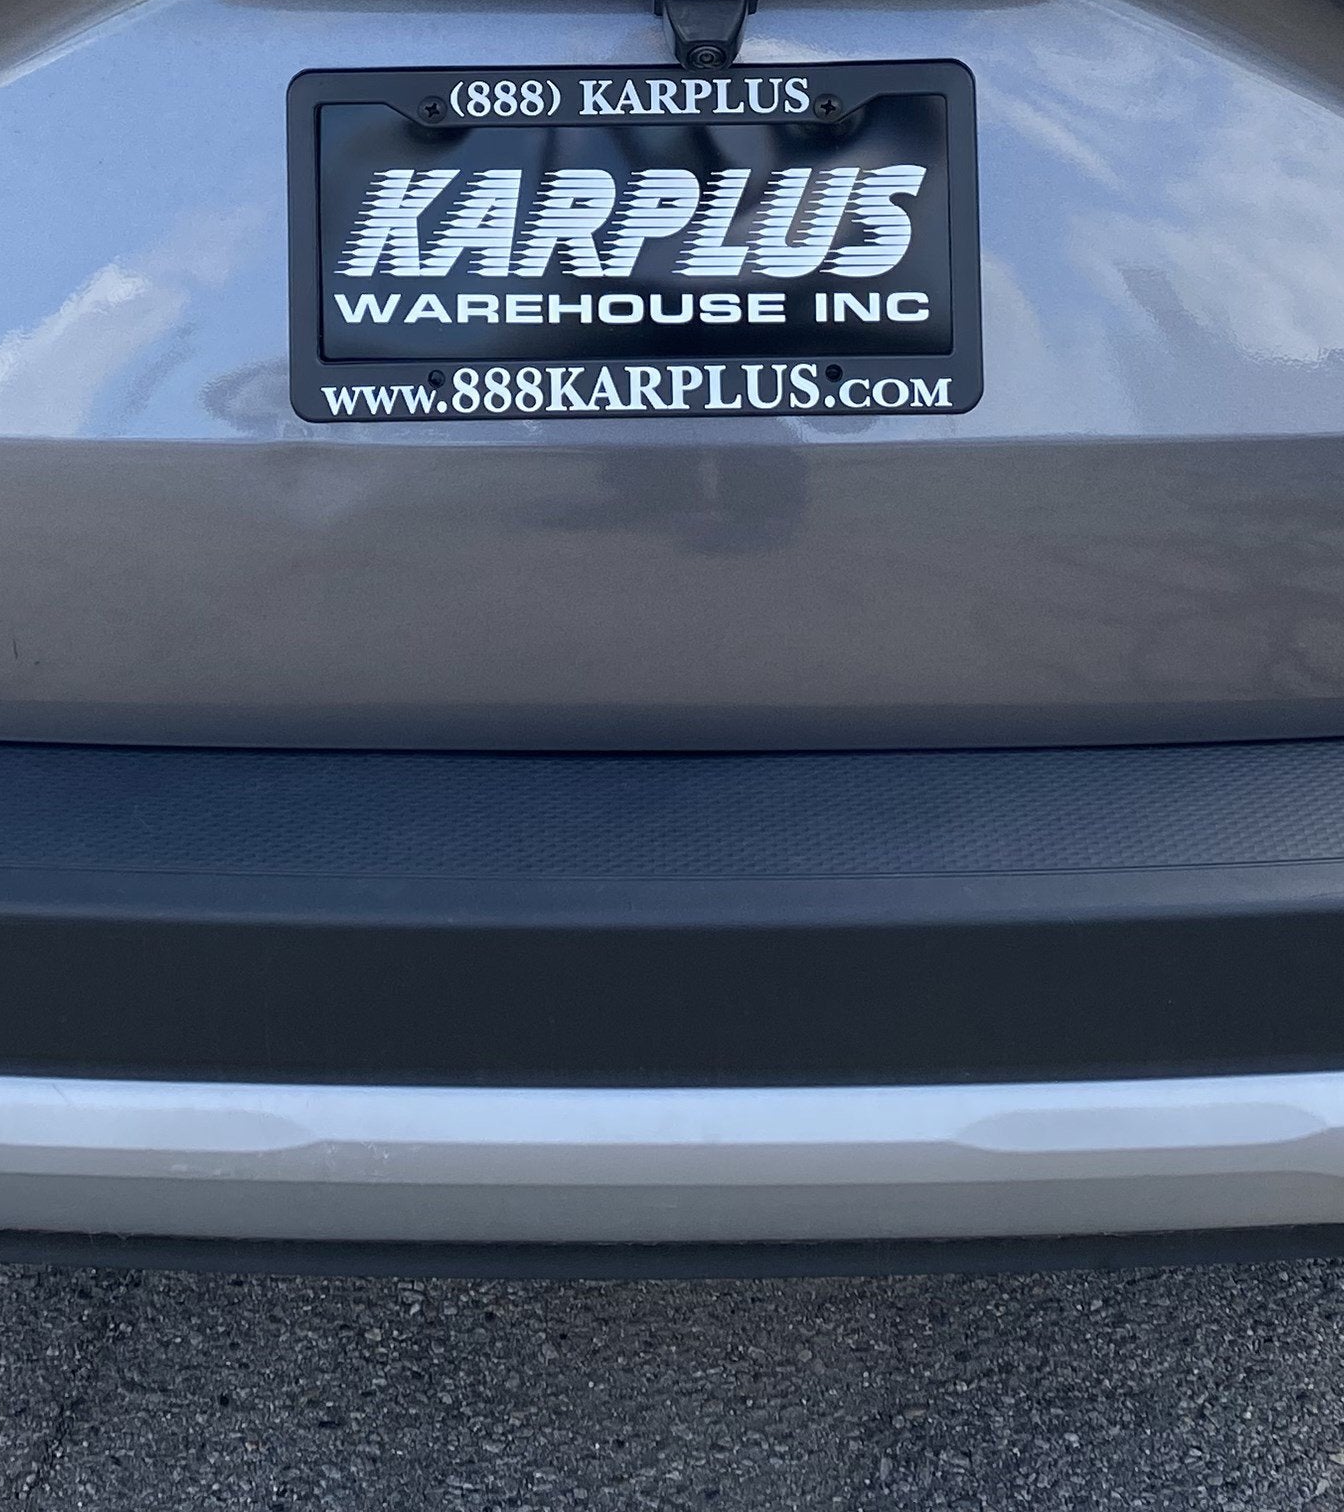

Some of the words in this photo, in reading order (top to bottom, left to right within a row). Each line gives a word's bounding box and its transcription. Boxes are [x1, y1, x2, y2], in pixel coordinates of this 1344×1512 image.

[449, 79, 563, 119] (888)
[580, 77, 811, 117] KARPLUS
[333, 164, 928, 278] KARPLUS
[335, 292, 786, 325] WAREHOUSE
[815, 291, 931, 324] INC
